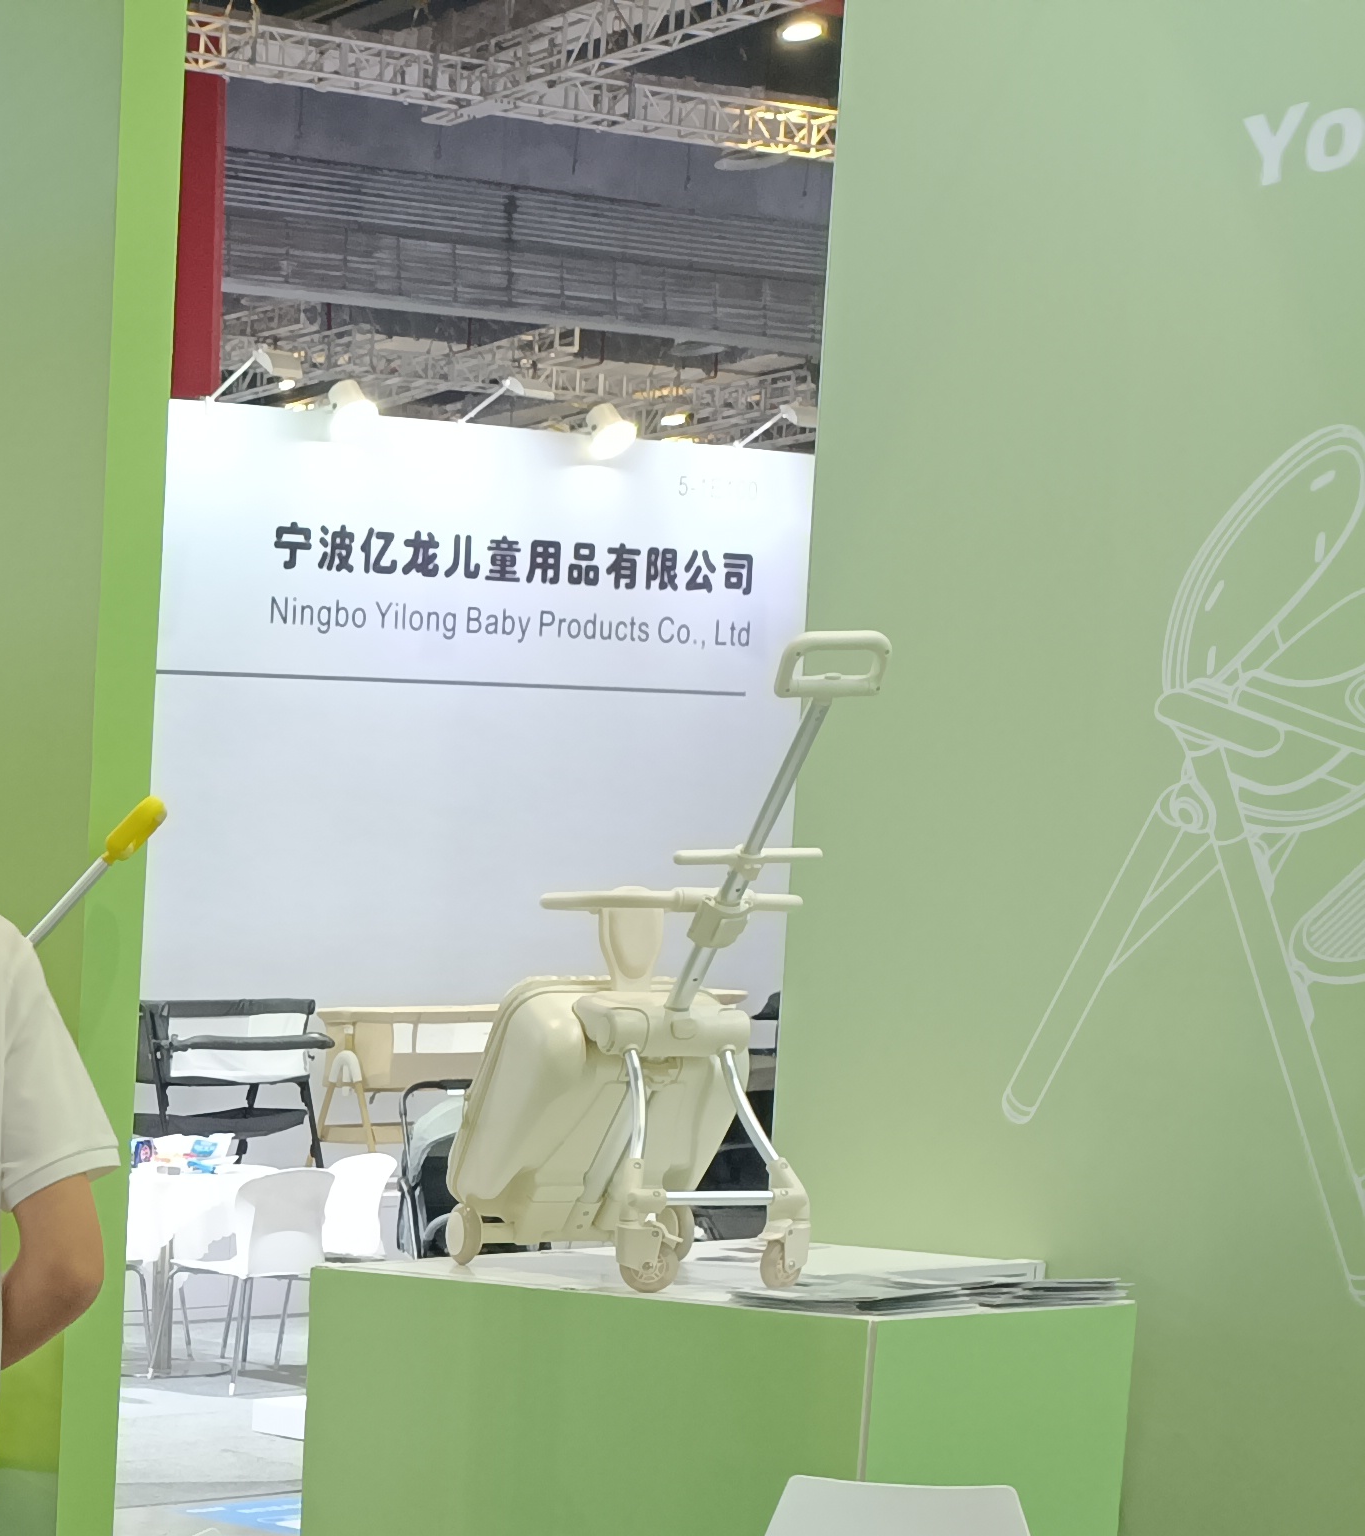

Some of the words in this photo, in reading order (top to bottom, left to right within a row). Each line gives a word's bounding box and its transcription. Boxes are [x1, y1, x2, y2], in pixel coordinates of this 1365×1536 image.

[274, 521, 754, 596] 宁波亿龙儿童用品有限公司
[270, 596, 367, 634] Ningbo
[376, 601, 457, 640] Yilong
[466, 606, 531, 643] Baby
[538, 610, 650, 643] Products
[657, 616, 706, 650] Co.,
[714, 619, 751, 647] Ltd
